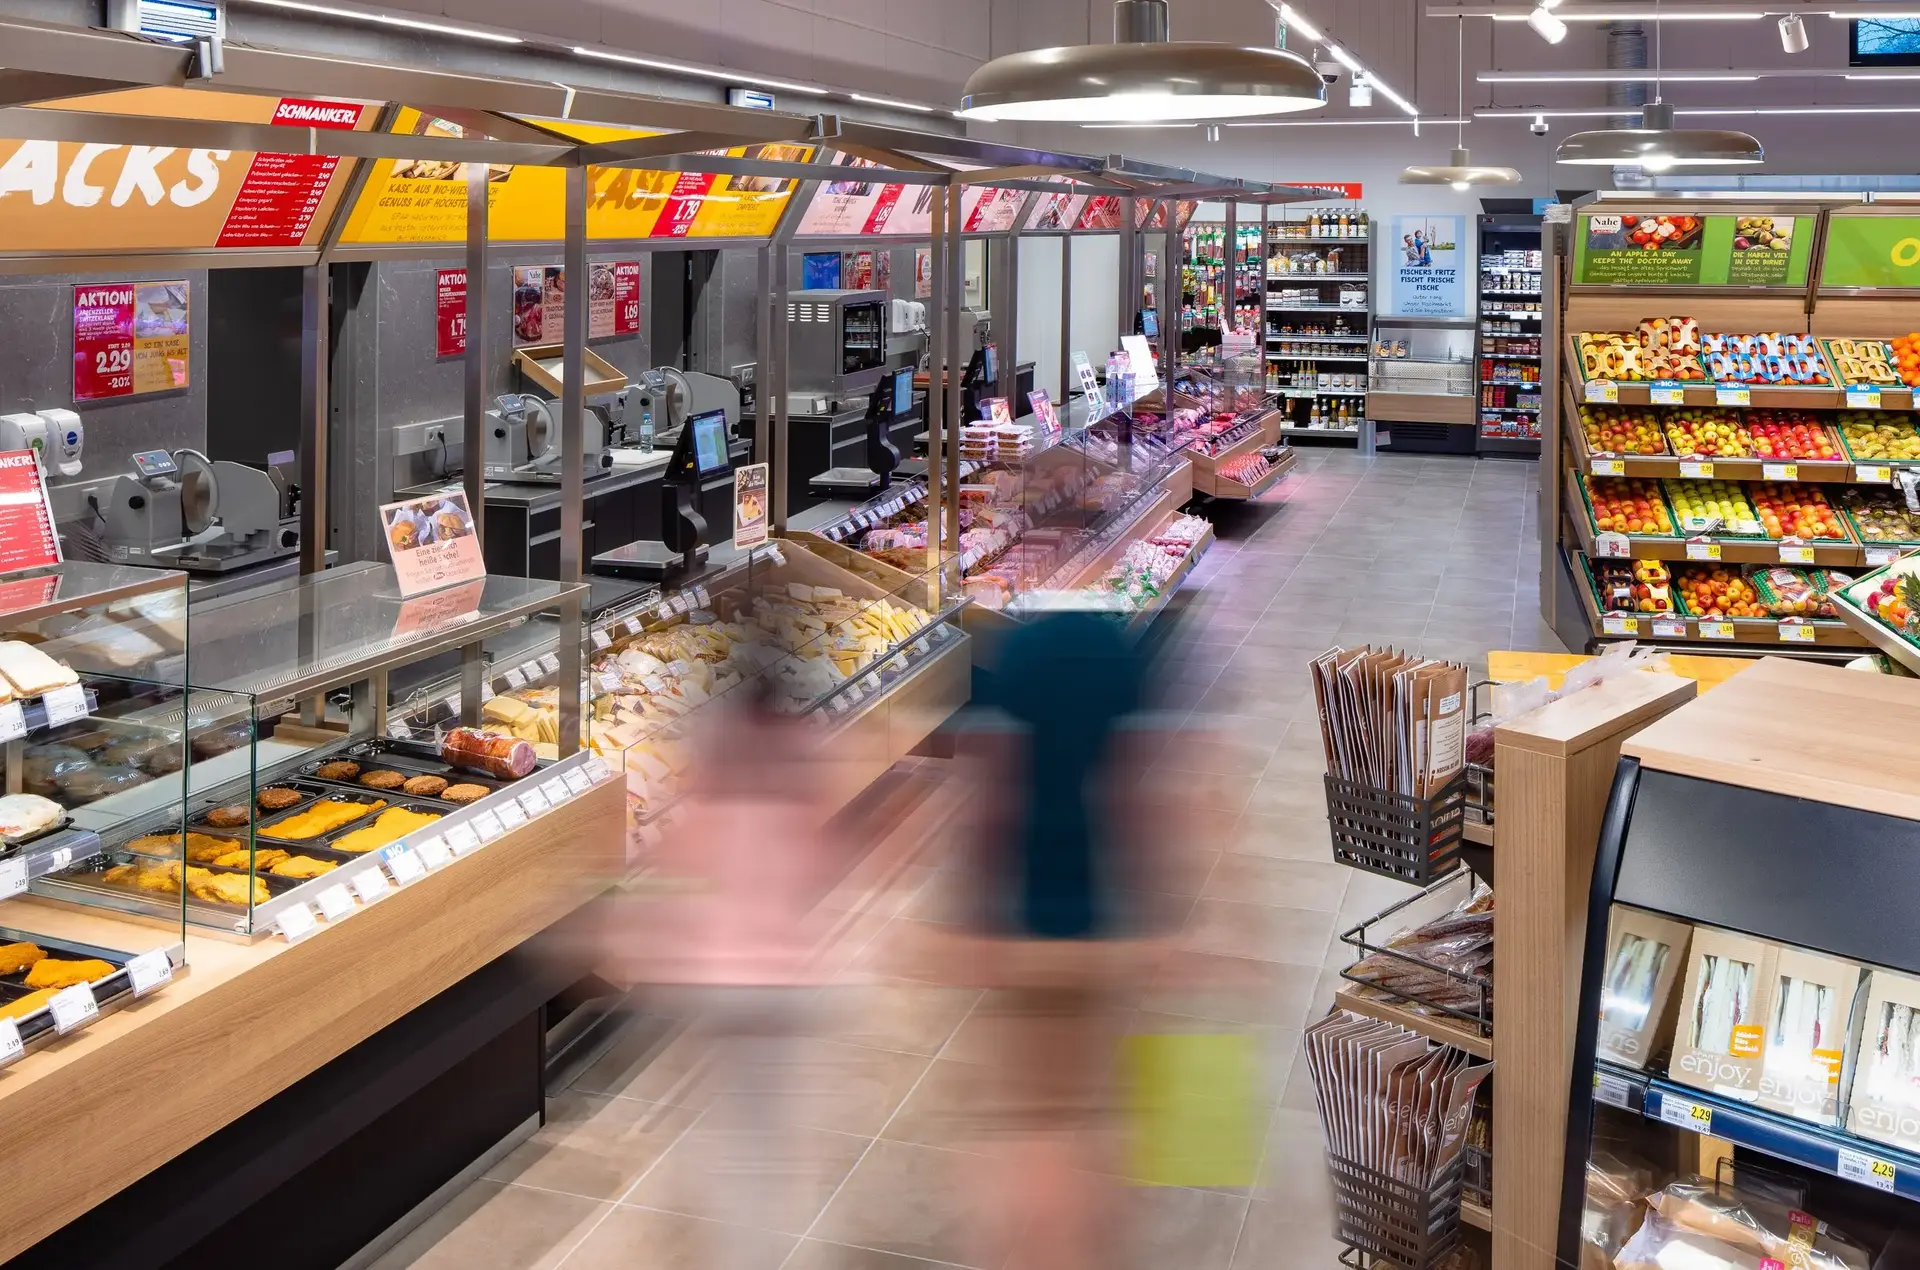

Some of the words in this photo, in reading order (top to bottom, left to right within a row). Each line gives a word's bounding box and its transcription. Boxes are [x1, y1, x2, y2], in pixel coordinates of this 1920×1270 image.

[277, 103, 356, 123] SCHMANKERL
[0, 139, 232, 207] ACKS
[413, 184, 431, 194] AUS
[379, 197, 412, 207] GENUSS
[414, 198, 433, 208] AUF
[673, 200, 700, 221] 1.79
[78, 290, 133, 307] AKTION!
[625, 304, 638, 320] 1.69
[96, 349, 131, 374] 2.29
[108, 376, 130, 388] -20%
[416, 547, 431, 558] Eine
[418, 556, 438, 567] heiße
[1691, 1106, 1711, 1122] 2,29
[1872, 1161, 1894, 1178] 2,29
[1876, 1181, 1894, 1190] 13,47
